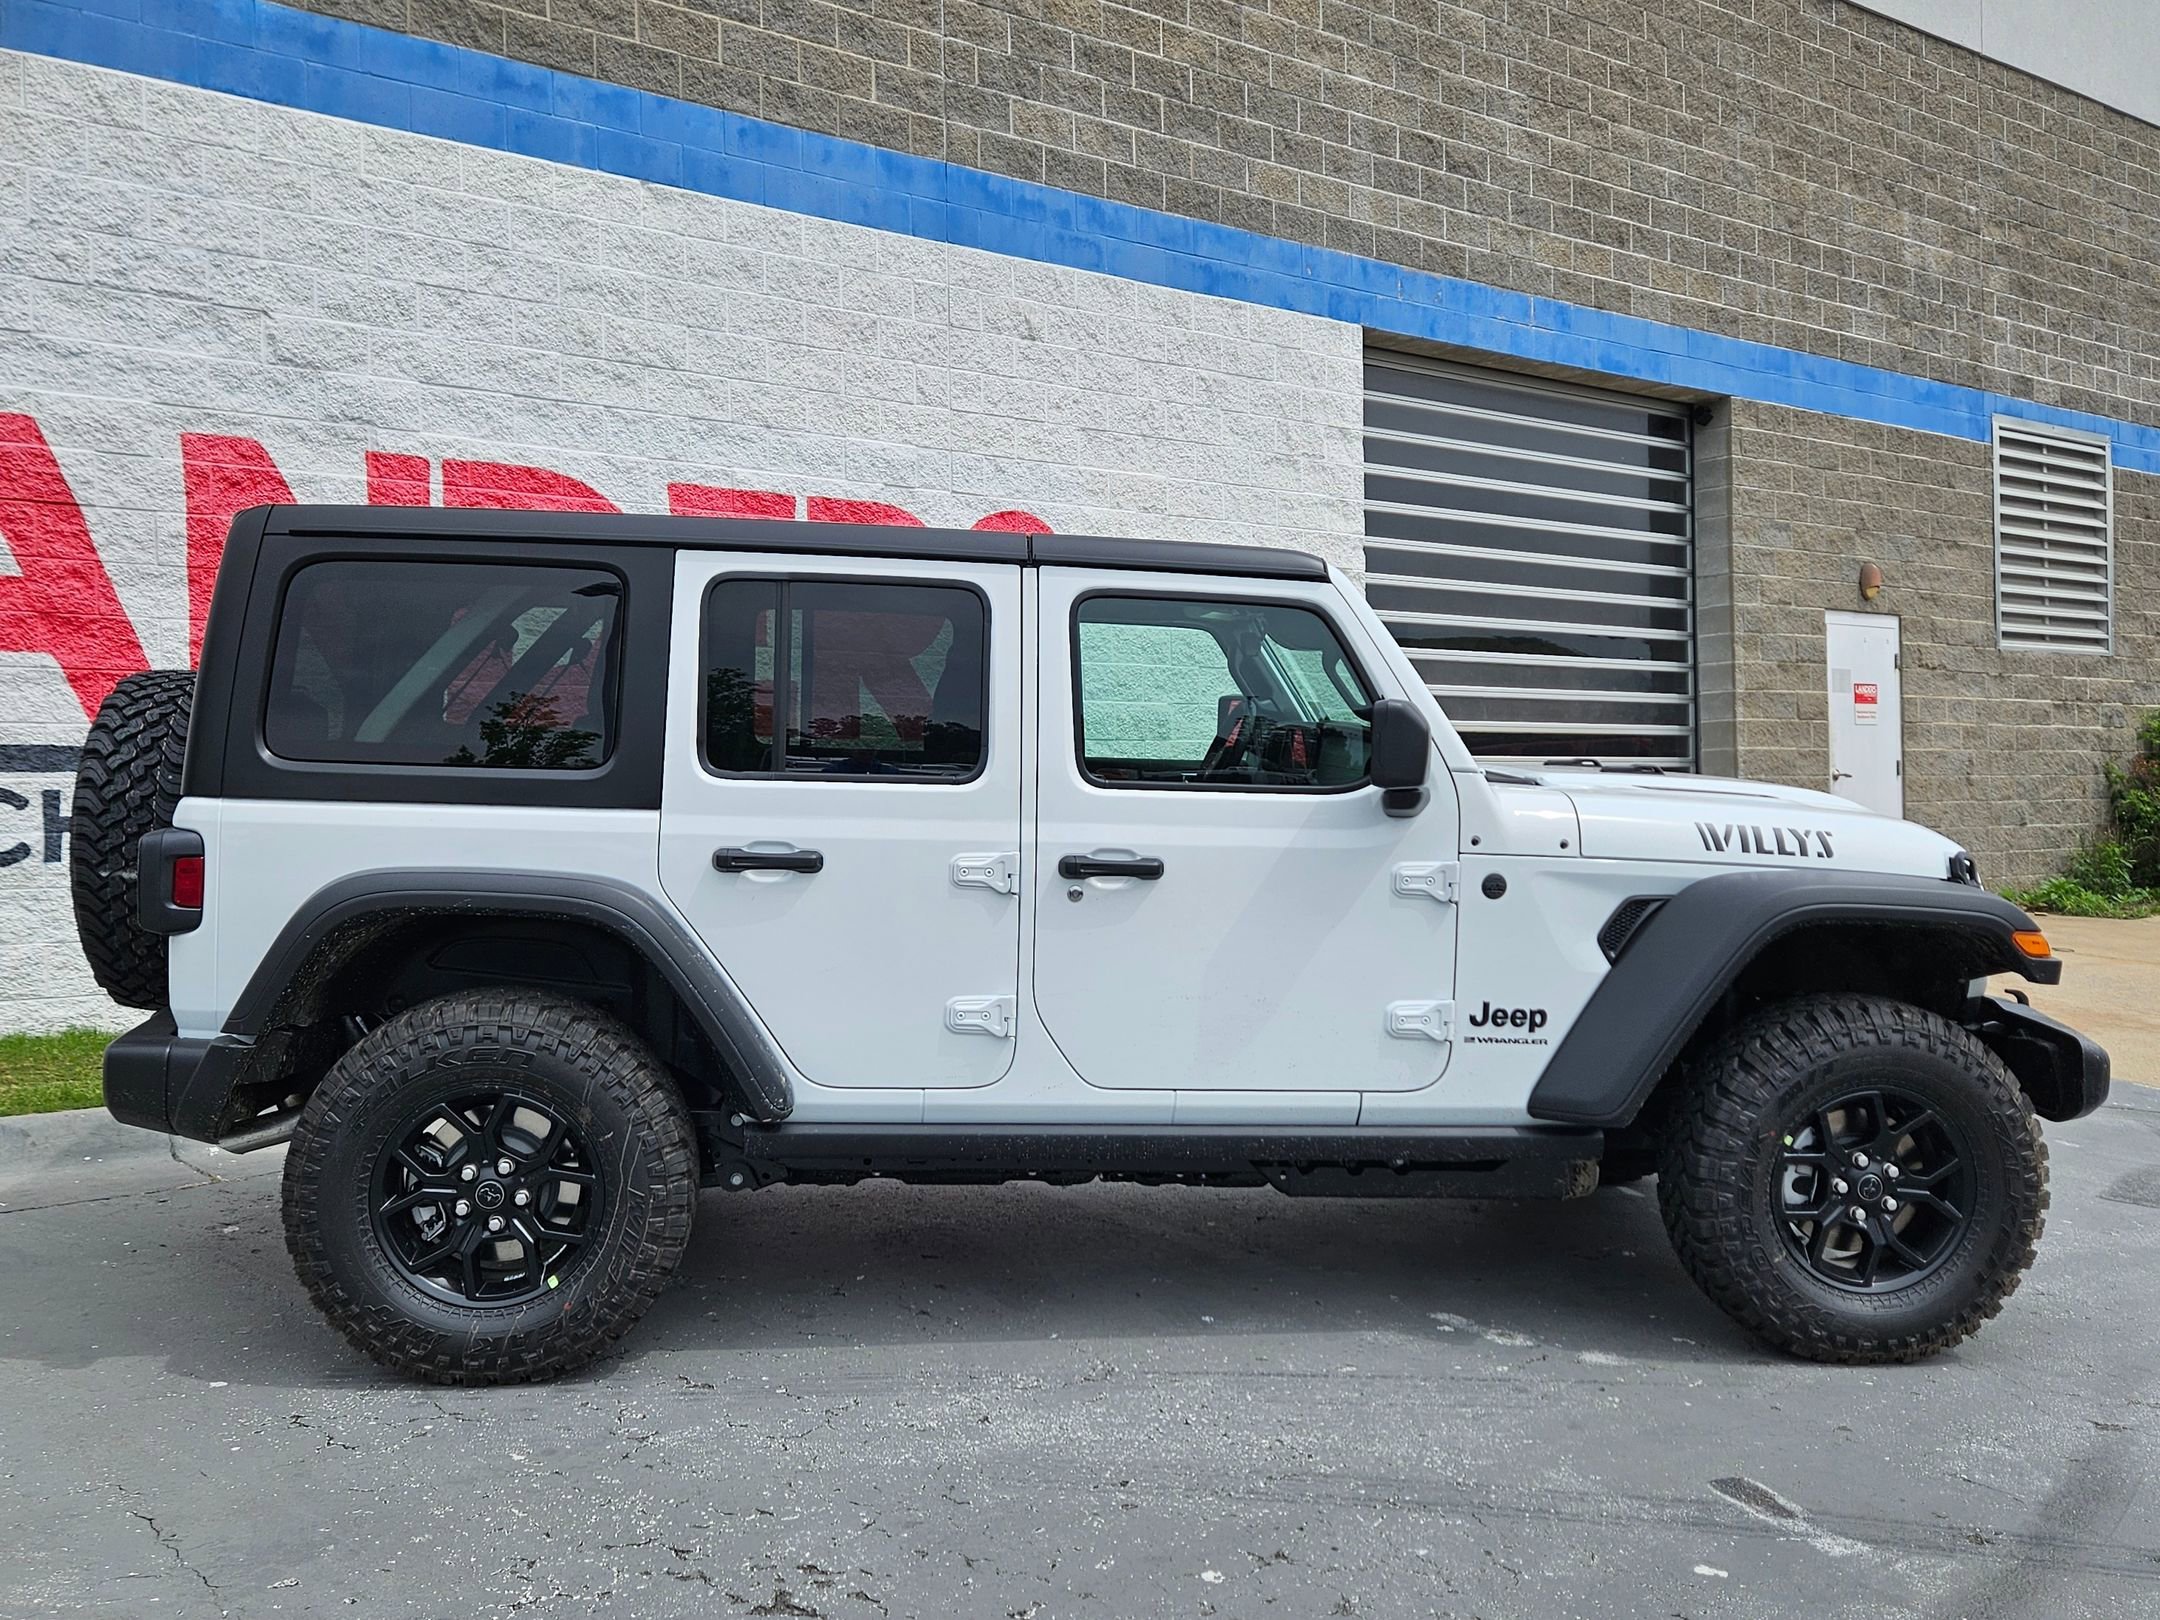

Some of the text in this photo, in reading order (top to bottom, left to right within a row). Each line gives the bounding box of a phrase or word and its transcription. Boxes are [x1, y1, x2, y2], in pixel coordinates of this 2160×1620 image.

[1694, 821, 1834, 859] WILLYS
[1469, 1000, 1548, 1033] Jeep
[1477, 1036, 1548, 1045] WRANGLER
